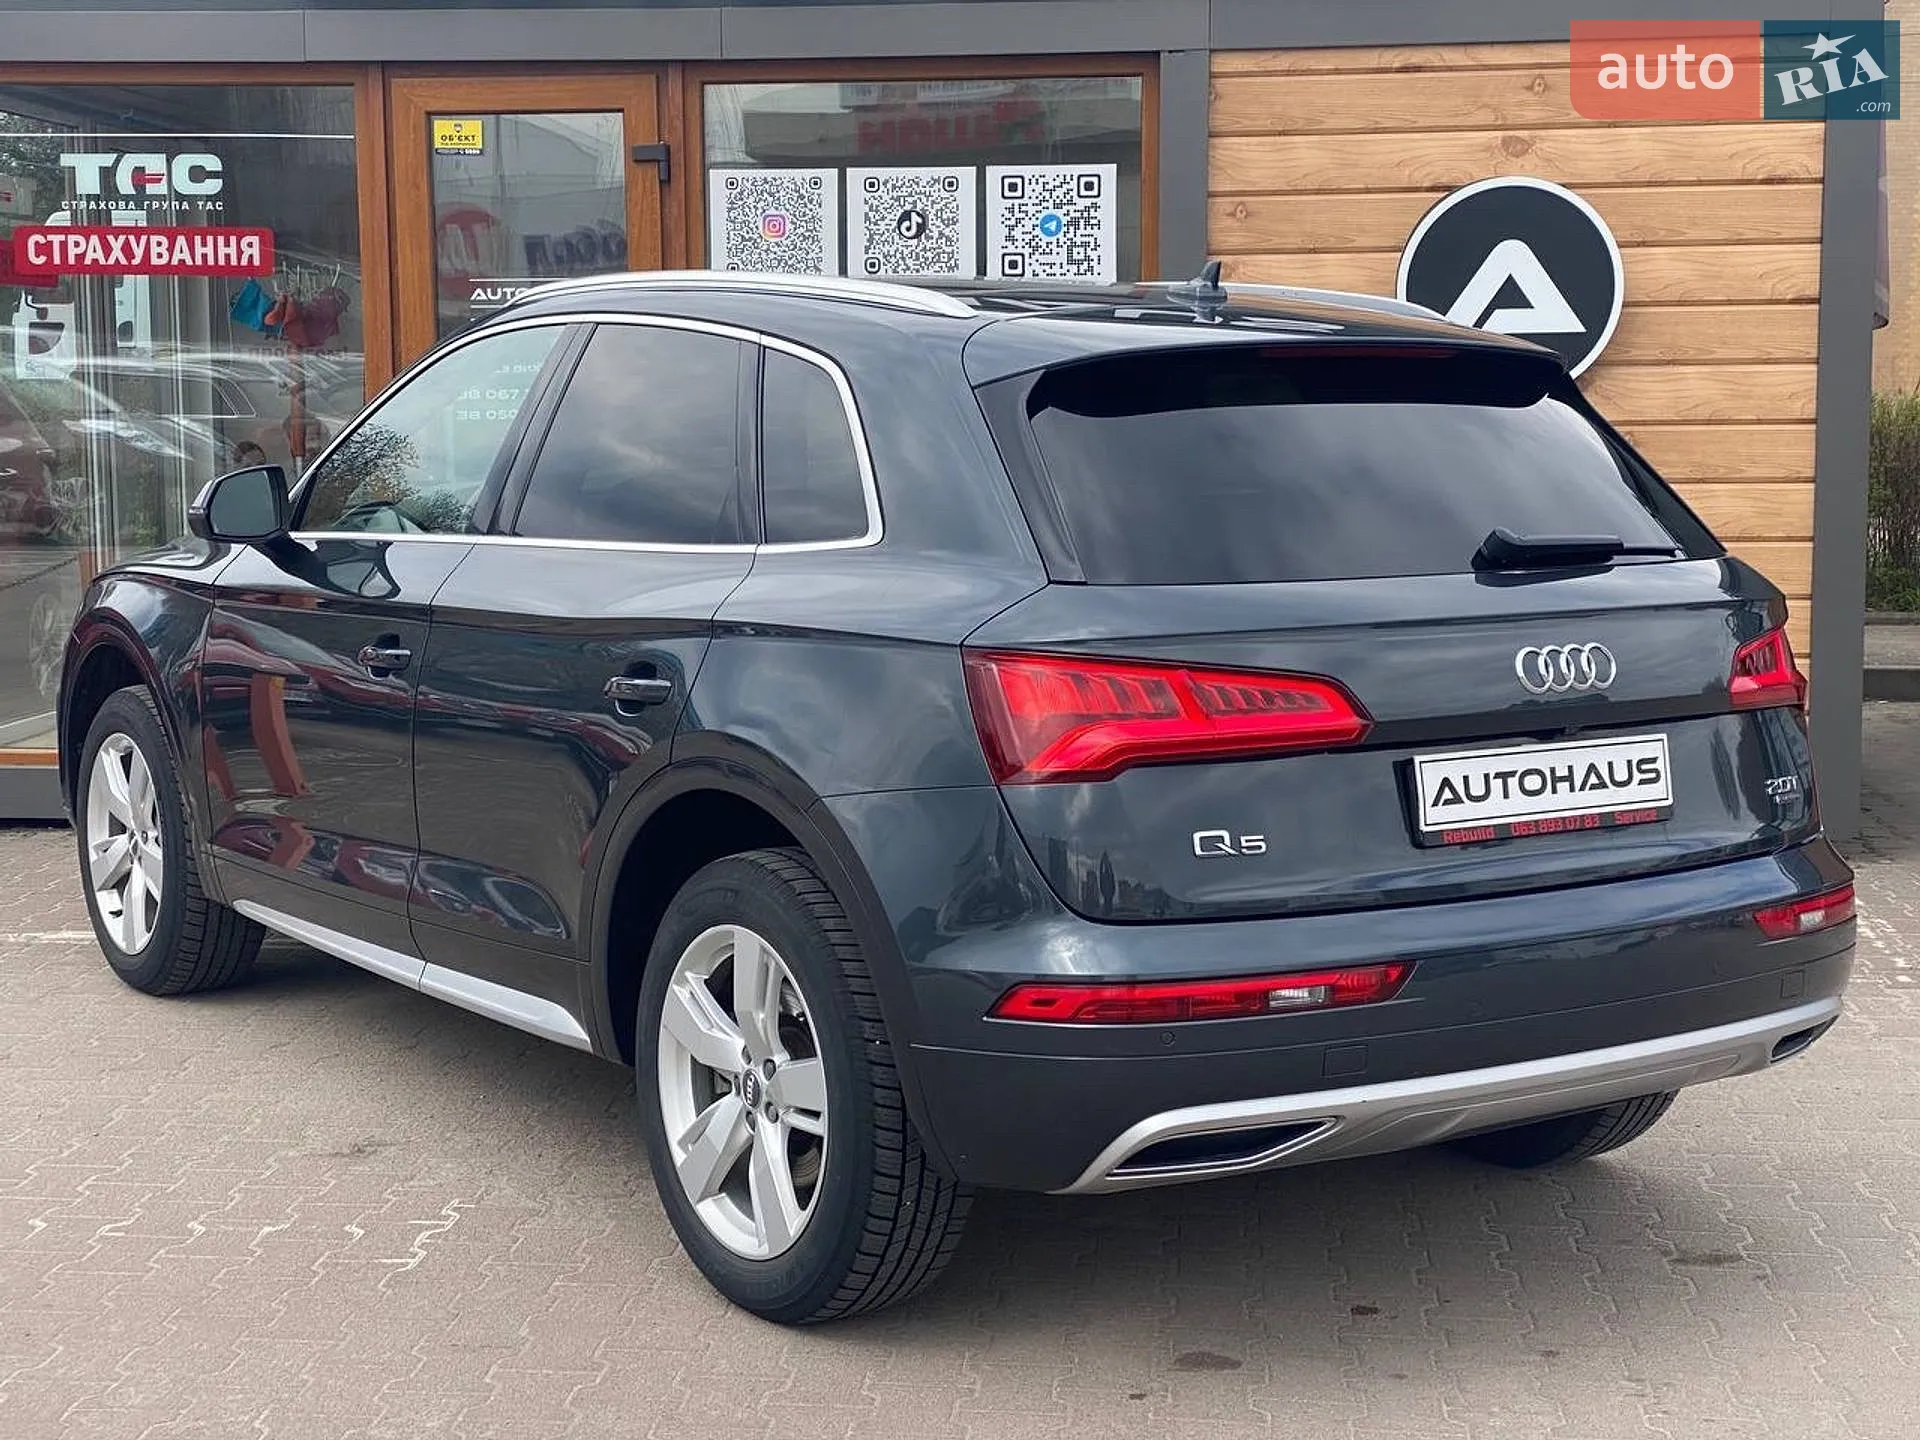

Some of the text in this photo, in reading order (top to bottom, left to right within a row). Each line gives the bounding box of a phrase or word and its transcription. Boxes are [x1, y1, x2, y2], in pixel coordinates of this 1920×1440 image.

[60, 153, 223, 195] ТАС
[61, 201, 224, 210] СТРАХОВА ГРУПА ТАС
[27, 234, 261, 267] СТРАХУВАННЯ
[1431, 756, 1662, 808] AUTOHAUS
